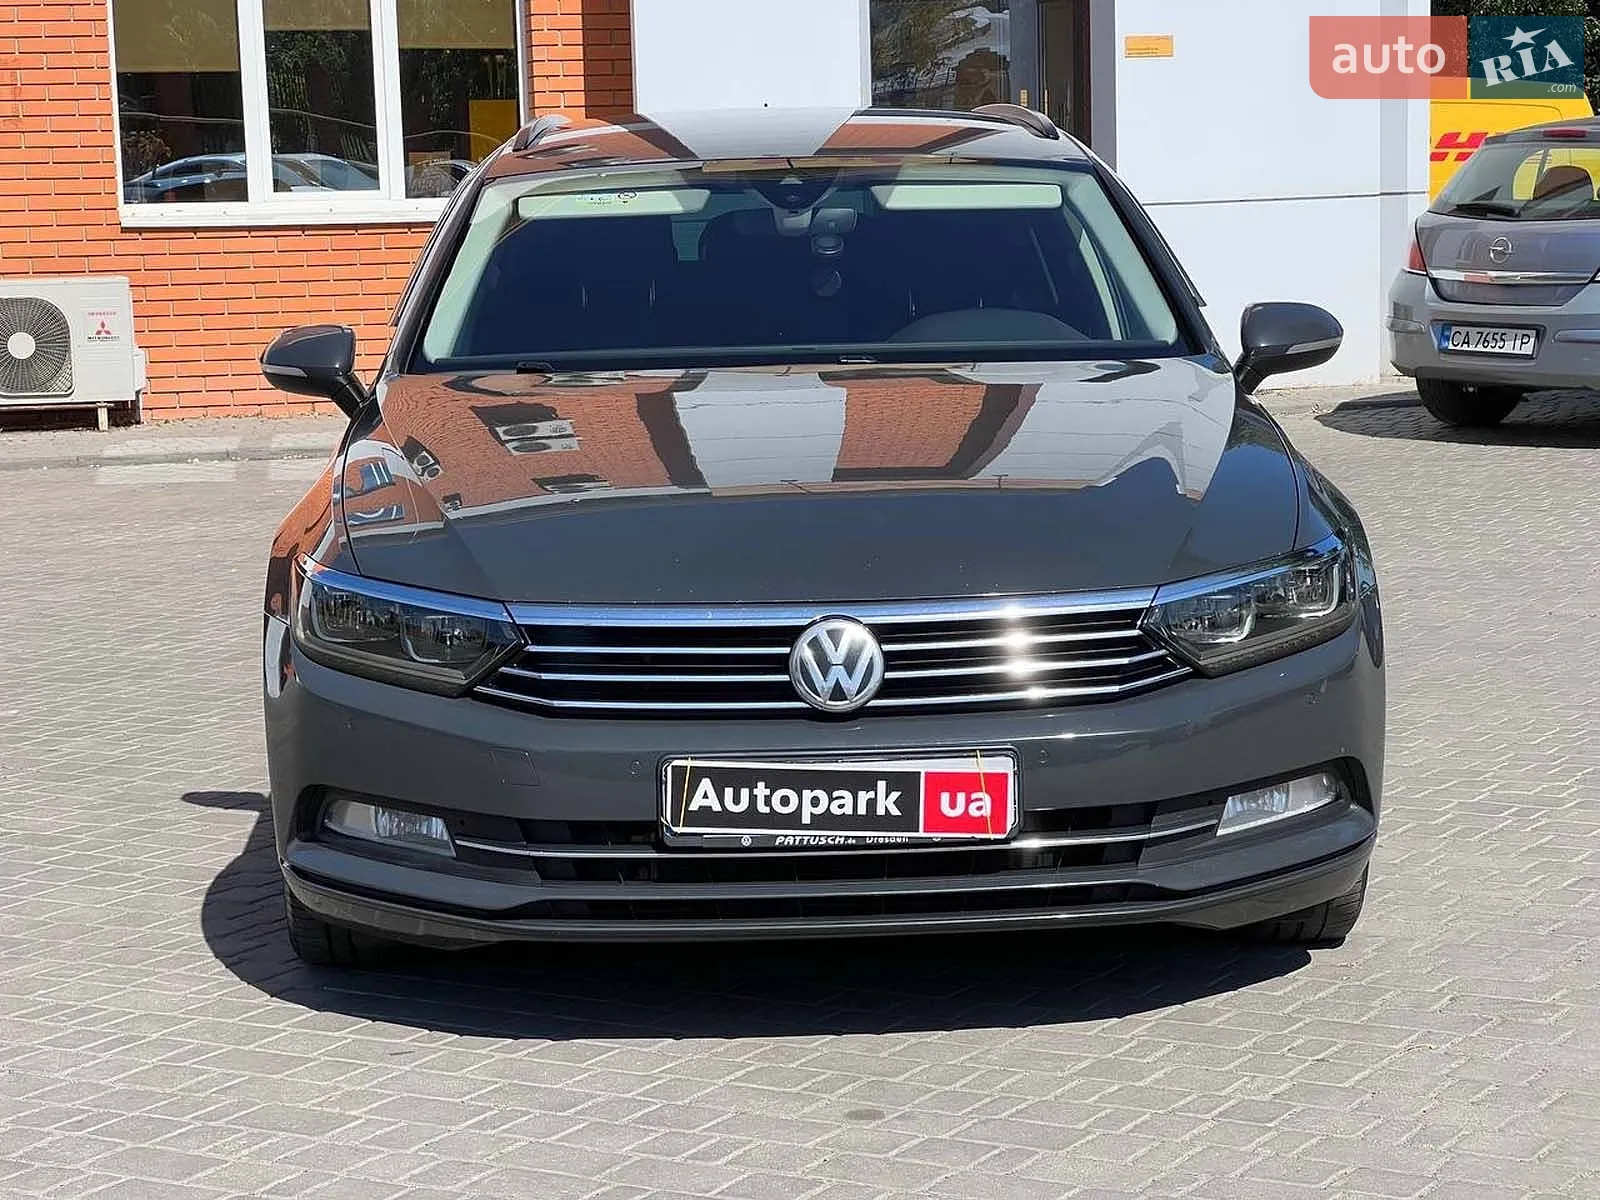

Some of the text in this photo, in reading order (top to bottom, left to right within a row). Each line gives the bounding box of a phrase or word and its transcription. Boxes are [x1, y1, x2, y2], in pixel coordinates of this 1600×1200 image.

[1451, 331, 1531, 351] CA 7655 IP
[688, 777, 993, 824] Autopark ua
